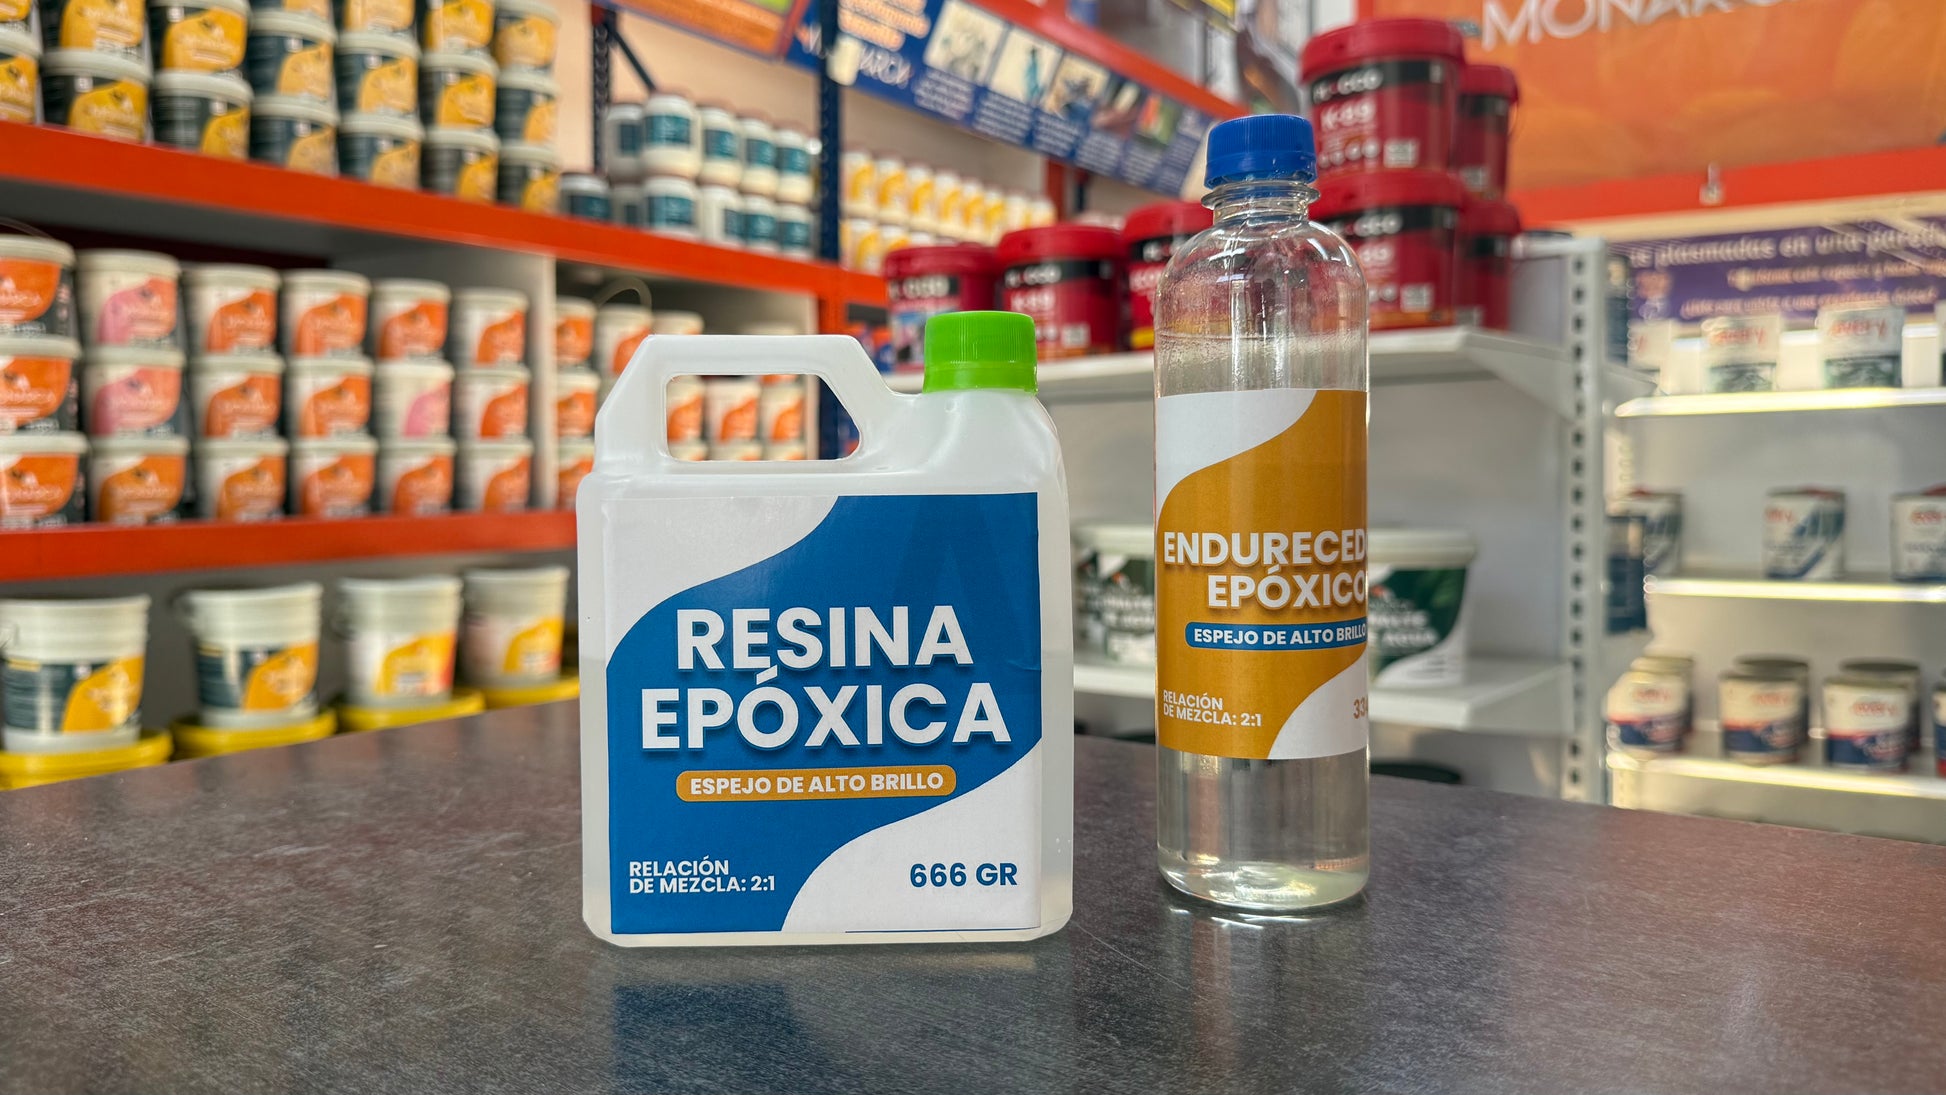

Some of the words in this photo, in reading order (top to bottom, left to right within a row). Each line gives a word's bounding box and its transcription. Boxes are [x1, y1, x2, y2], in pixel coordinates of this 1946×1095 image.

[1164, 528, 1367, 565] ENDURECED
[1208, 566, 1366, 608] EPÓXICO
[677, 605, 974, 670] RESINA
[1194, 628, 1259, 645] ESPEJO
[1263, 630, 1287, 645] DE
[1290, 628, 1334, 645] ALTO
[1336, 623, 1367, 641] BRILLO
[641, 665, 1012, 749] EPÓXICA
[1163, 690, 1223, 711] RELACIÓN
[1163, 703, 1174, 718] DE
[1176, 706, 1237, 726] MEZCLA:
[1240, 713, 1262, 727] 2:1
[690, 777, 771, 795] ESPEJO
[776, 776, 804, 793] DE
[808, 775, 866, 793] ALTO
[871, 773, 944, 791] BRILLO
[629, 856, 729, 877] RELACIÓN
[910, 863, 967, 887] 666
[976, 863, 1018, 886] GR
[629, 878, 655, 894] DE
[659, 877, 746, 893] MEZCLA:
[751, 876, 776, 892] 2:1
